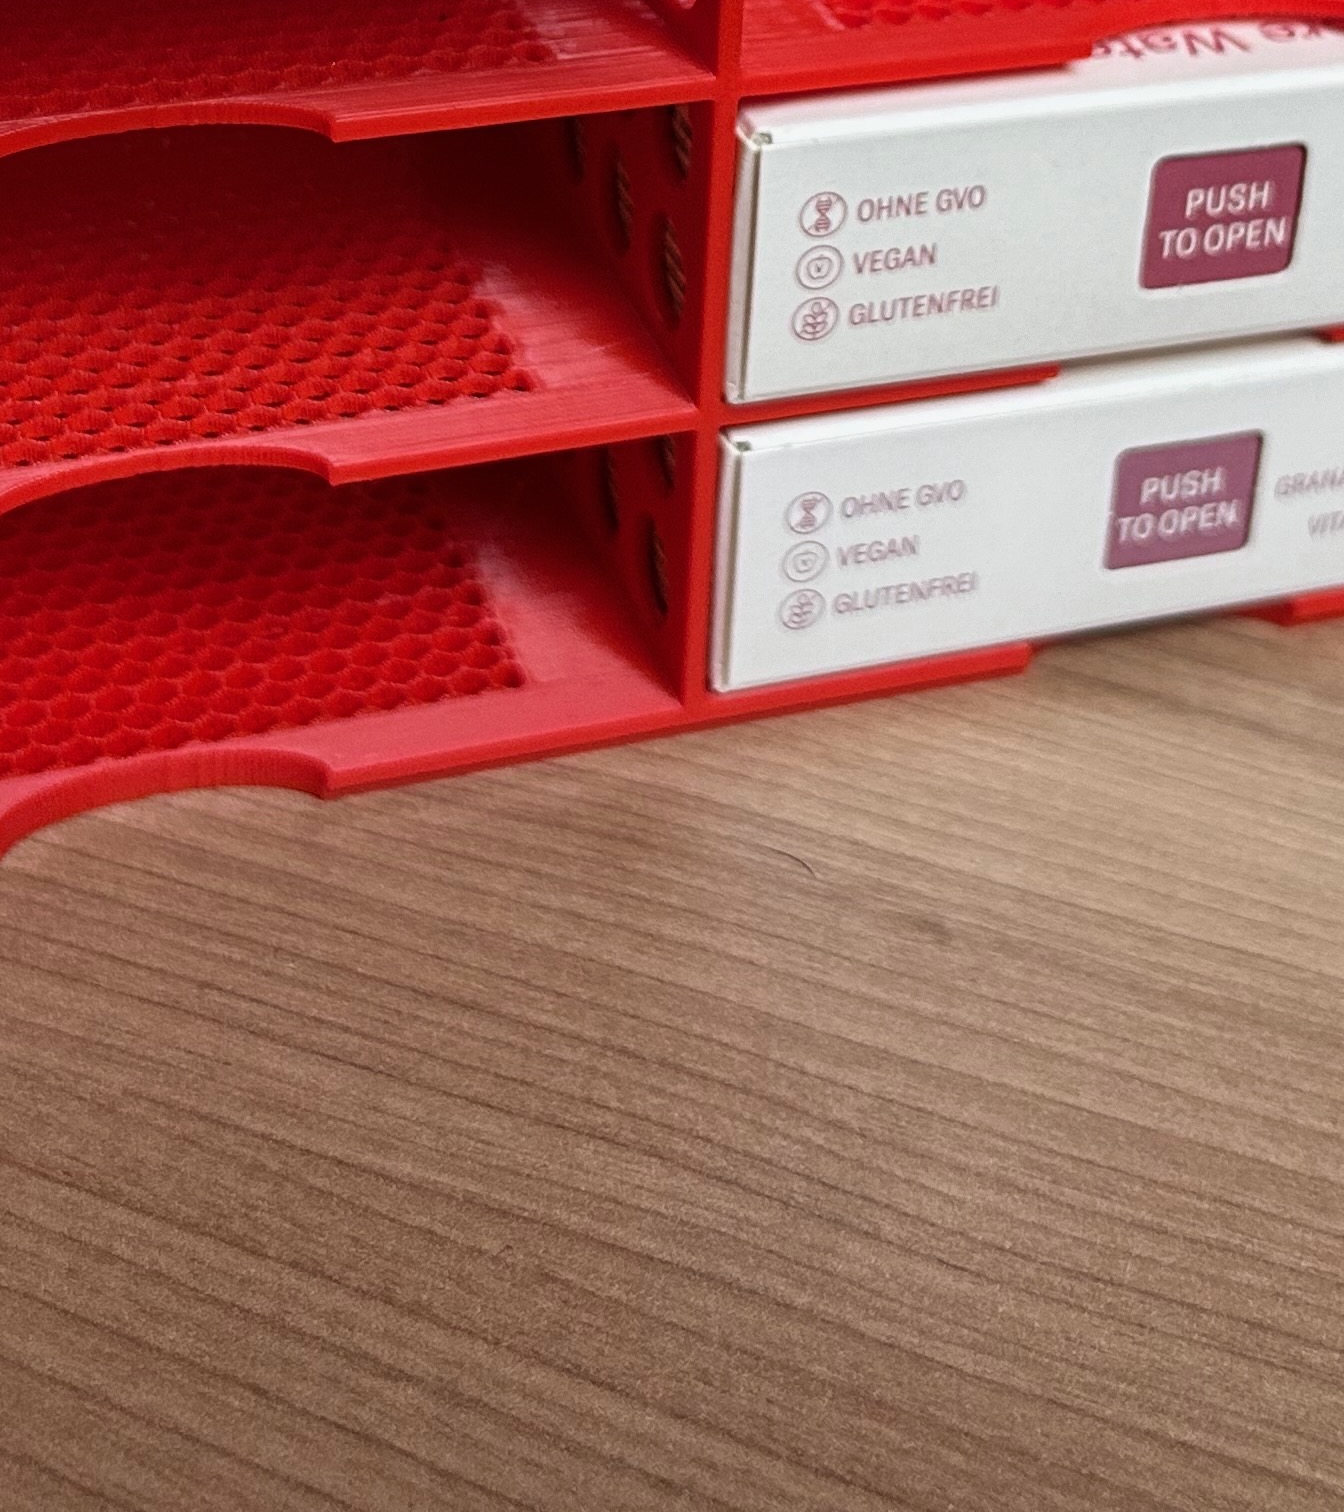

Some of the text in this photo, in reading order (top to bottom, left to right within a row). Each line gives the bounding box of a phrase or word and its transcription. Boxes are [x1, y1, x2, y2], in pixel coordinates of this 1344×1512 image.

[857, 183, 988, 223] OHNE GVO
[1185, 180, 1272, 219] PUSH
[1159, 215, 1288, 261] TO OPEN
[852, 242, 939, 276] VEGAN
[849, 285, 1000, 328] GLUTENFREI
[840, 478, 968, 519] OHNE GVO
[1140, 466, 1223, 506] PUSH
[1117, 501, 1239, 545] TO OPEN
[837, 535, 921, 568] VEGAN
[834, 572, 980, 616] GLUTENFREI
